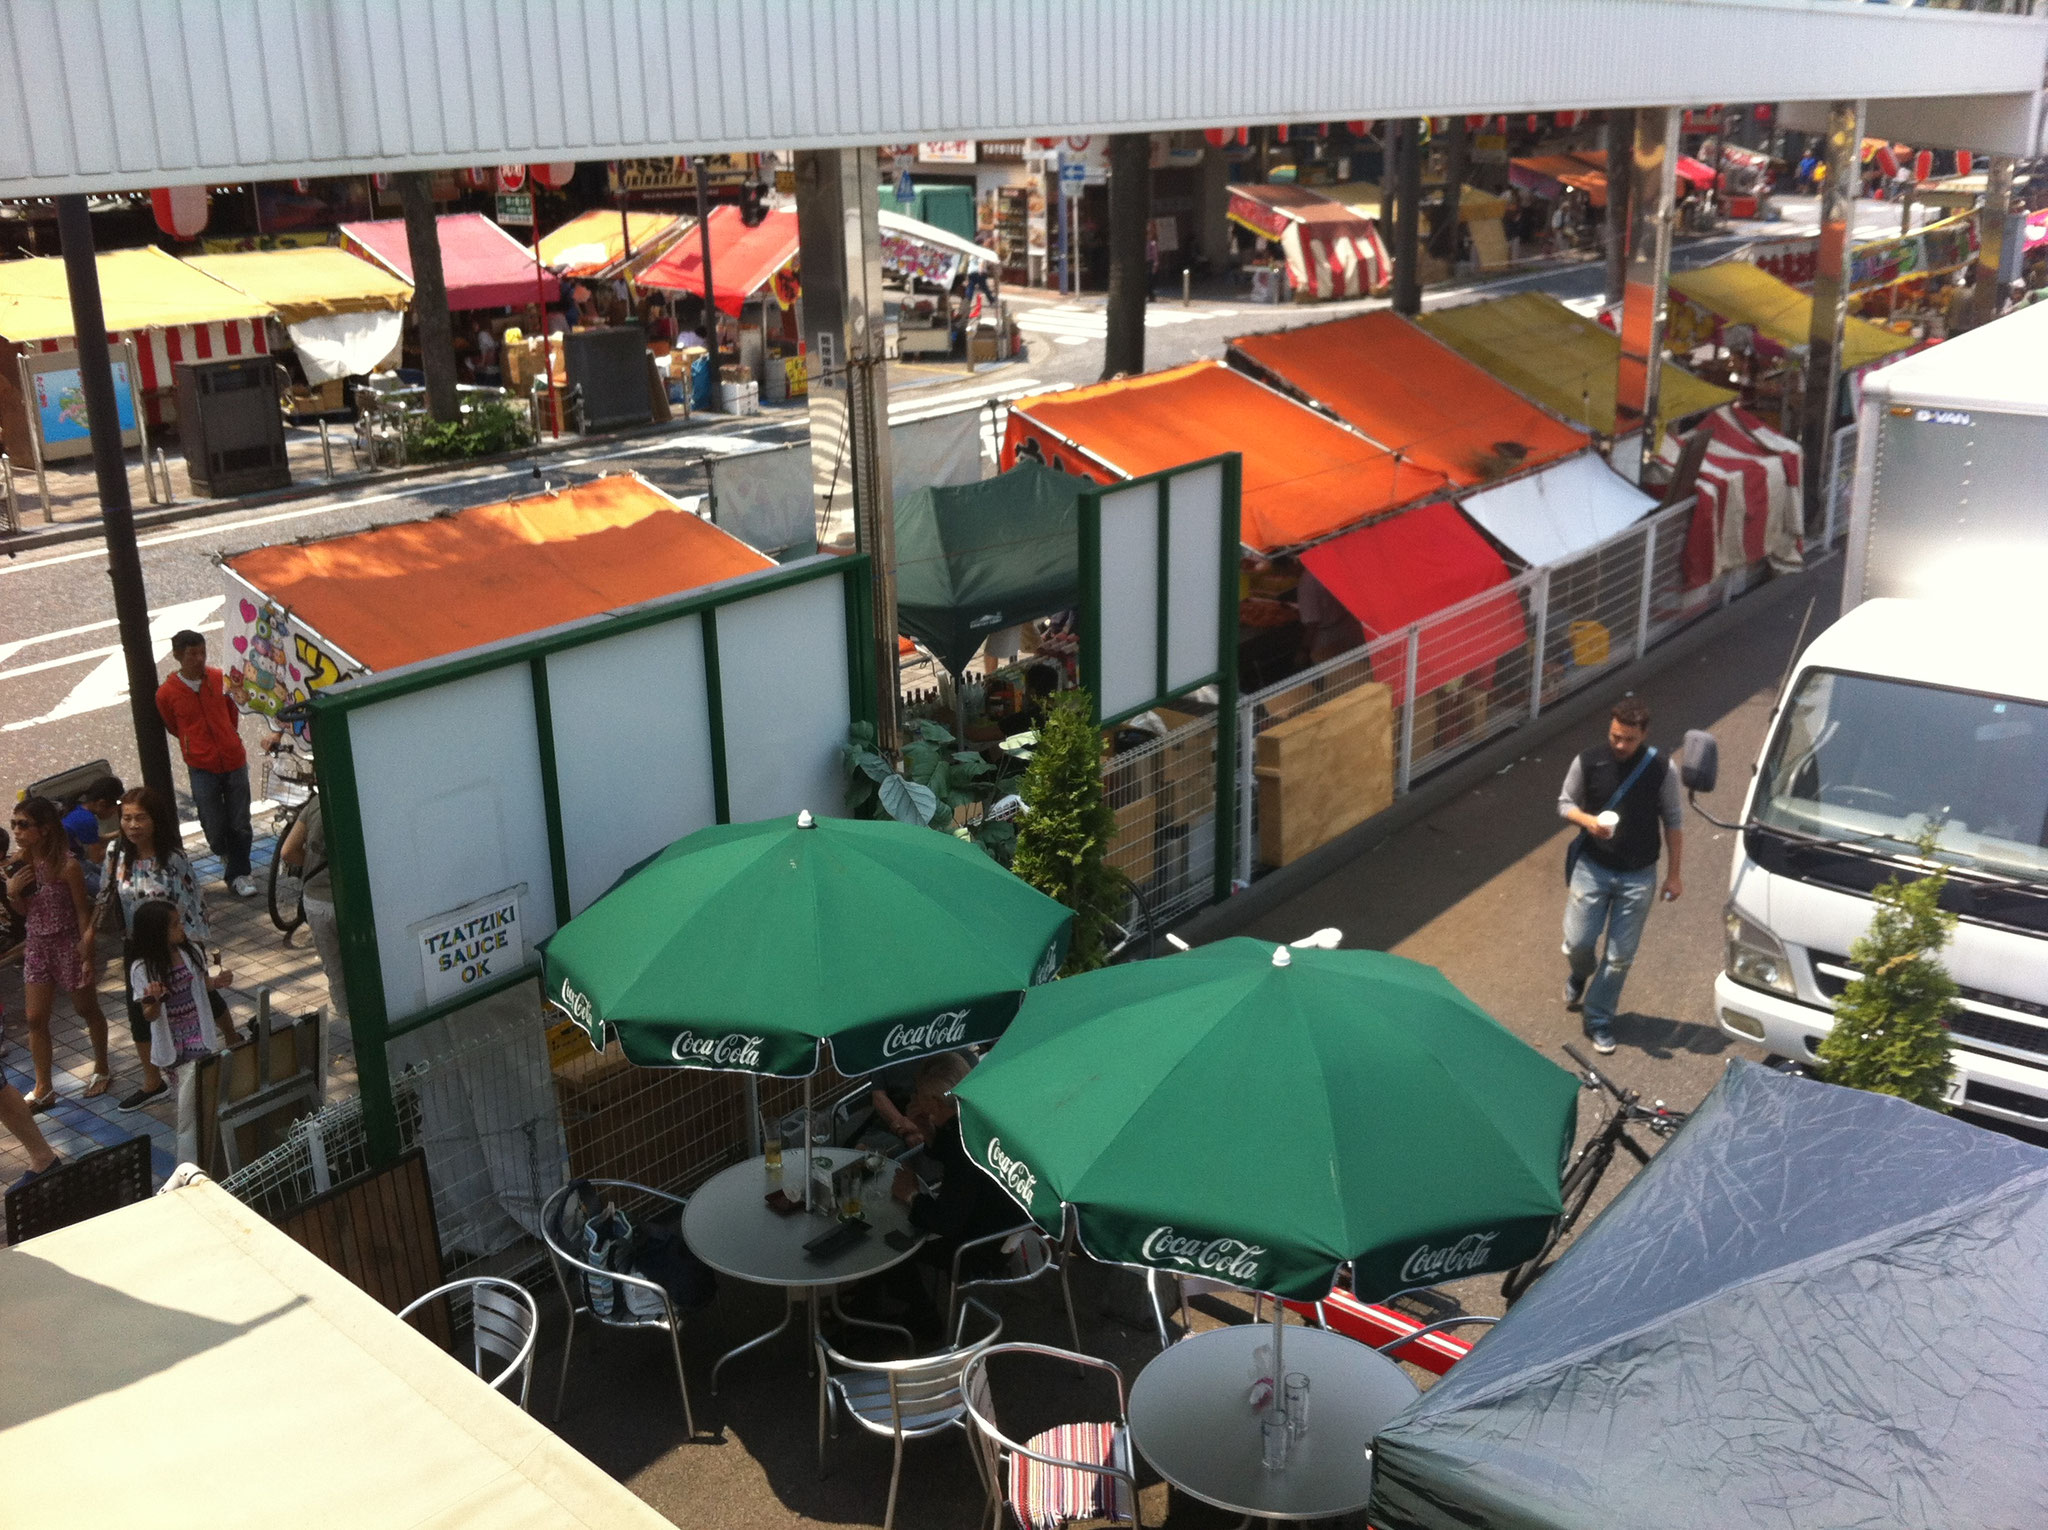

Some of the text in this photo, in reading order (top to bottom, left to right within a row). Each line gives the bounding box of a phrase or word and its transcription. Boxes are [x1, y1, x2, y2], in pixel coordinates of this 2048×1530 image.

[425, 905, 516, 955] TZATZIKI
[439, 929, 509, 972] SAUCE
[461, 957, 491, 984] OK
[671, 1030, 765, 1067] Coca-Cola
[882, 1008, 971, 1057] Coca-Cola
[1142, 1226, 1267, 1281] Coca-Cola
[1400, 1231, 1500, 1283] Coca-Cola
